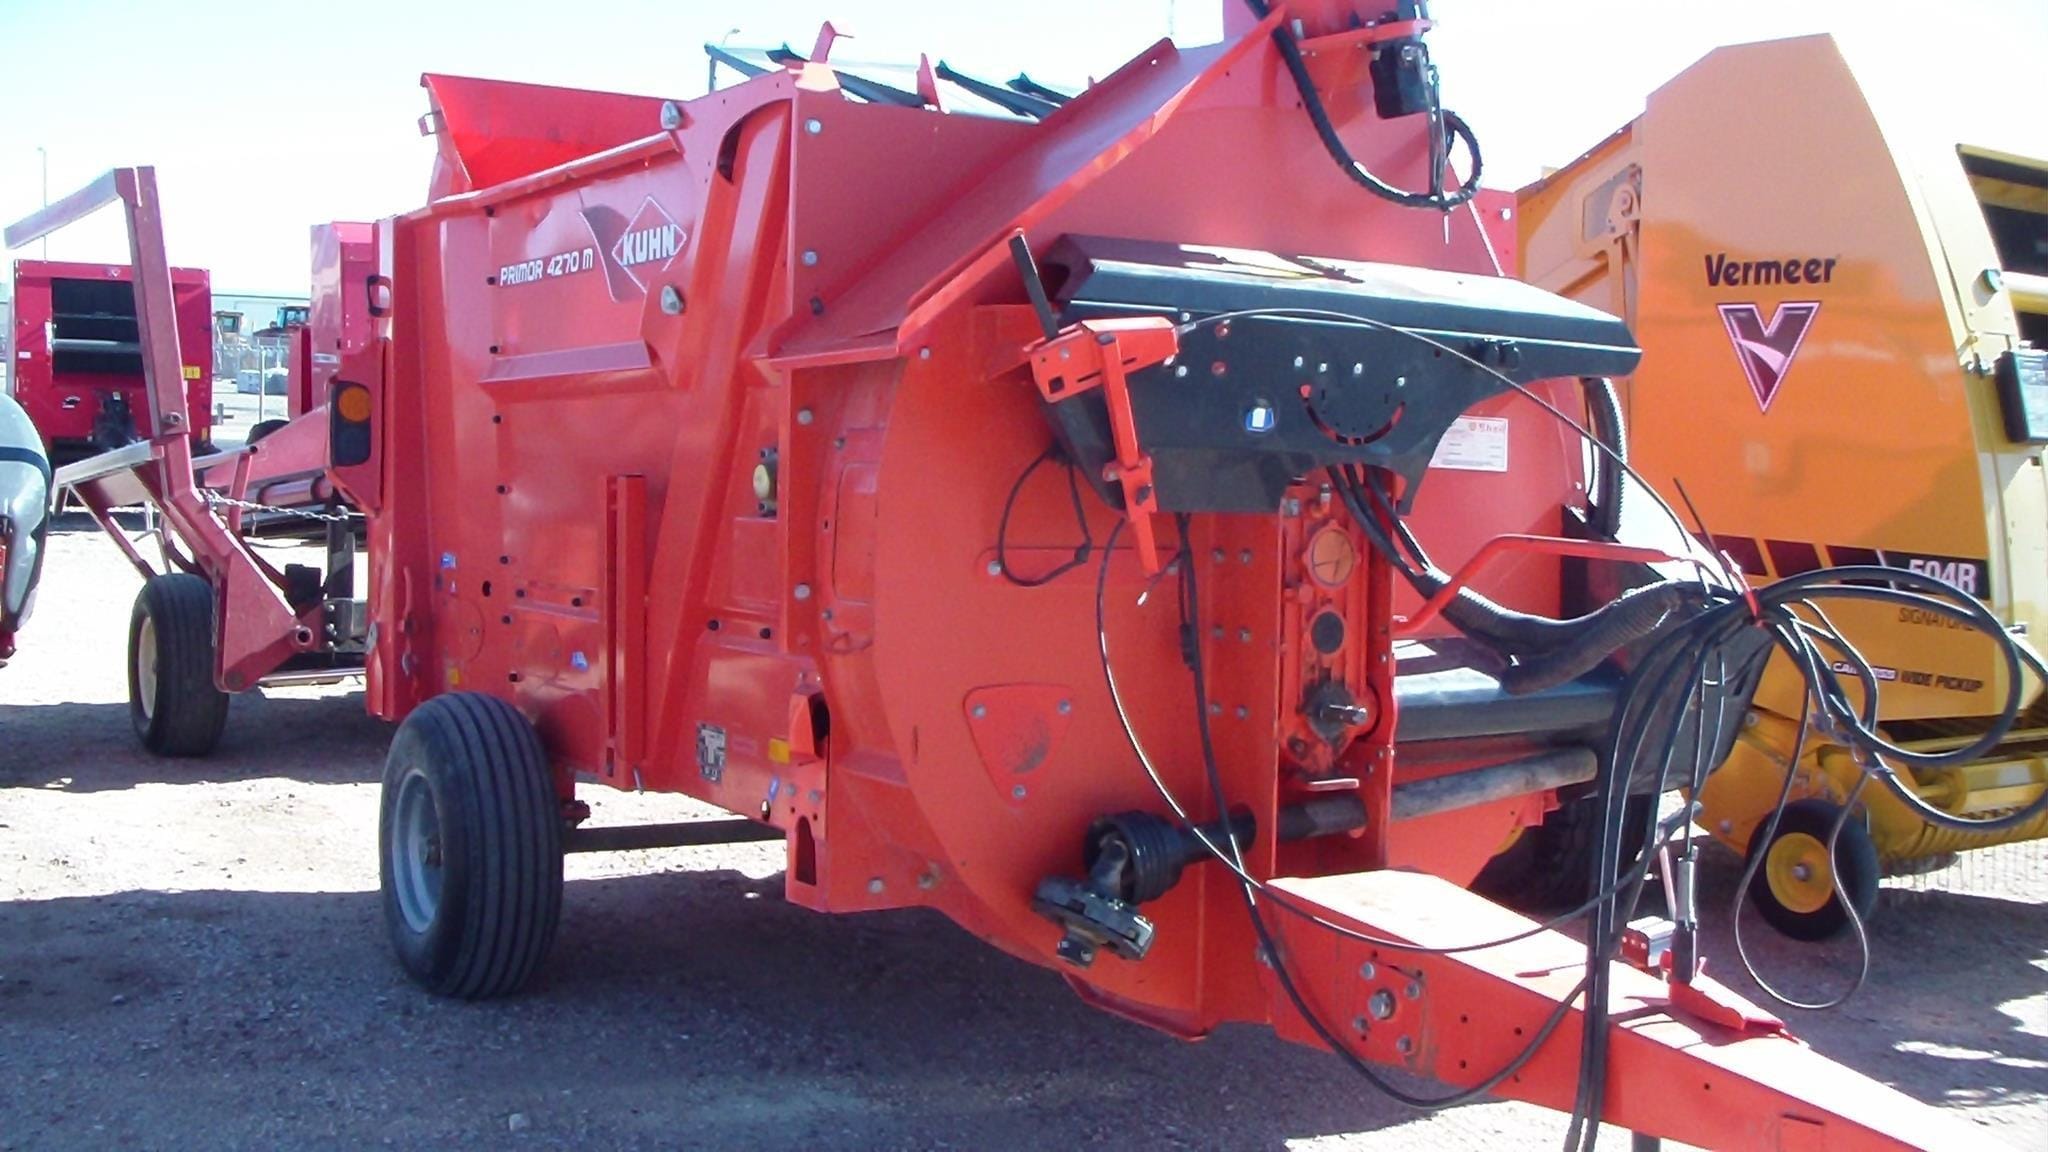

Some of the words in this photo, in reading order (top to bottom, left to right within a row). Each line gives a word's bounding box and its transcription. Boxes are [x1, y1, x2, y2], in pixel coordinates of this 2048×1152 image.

[622, 224, 676, 266] KUHN
[500, 261, 544, 287] PRIMOR
[547, 251, 579, 276] 4270
[1705, 253, 1836, 286] Vermeer
